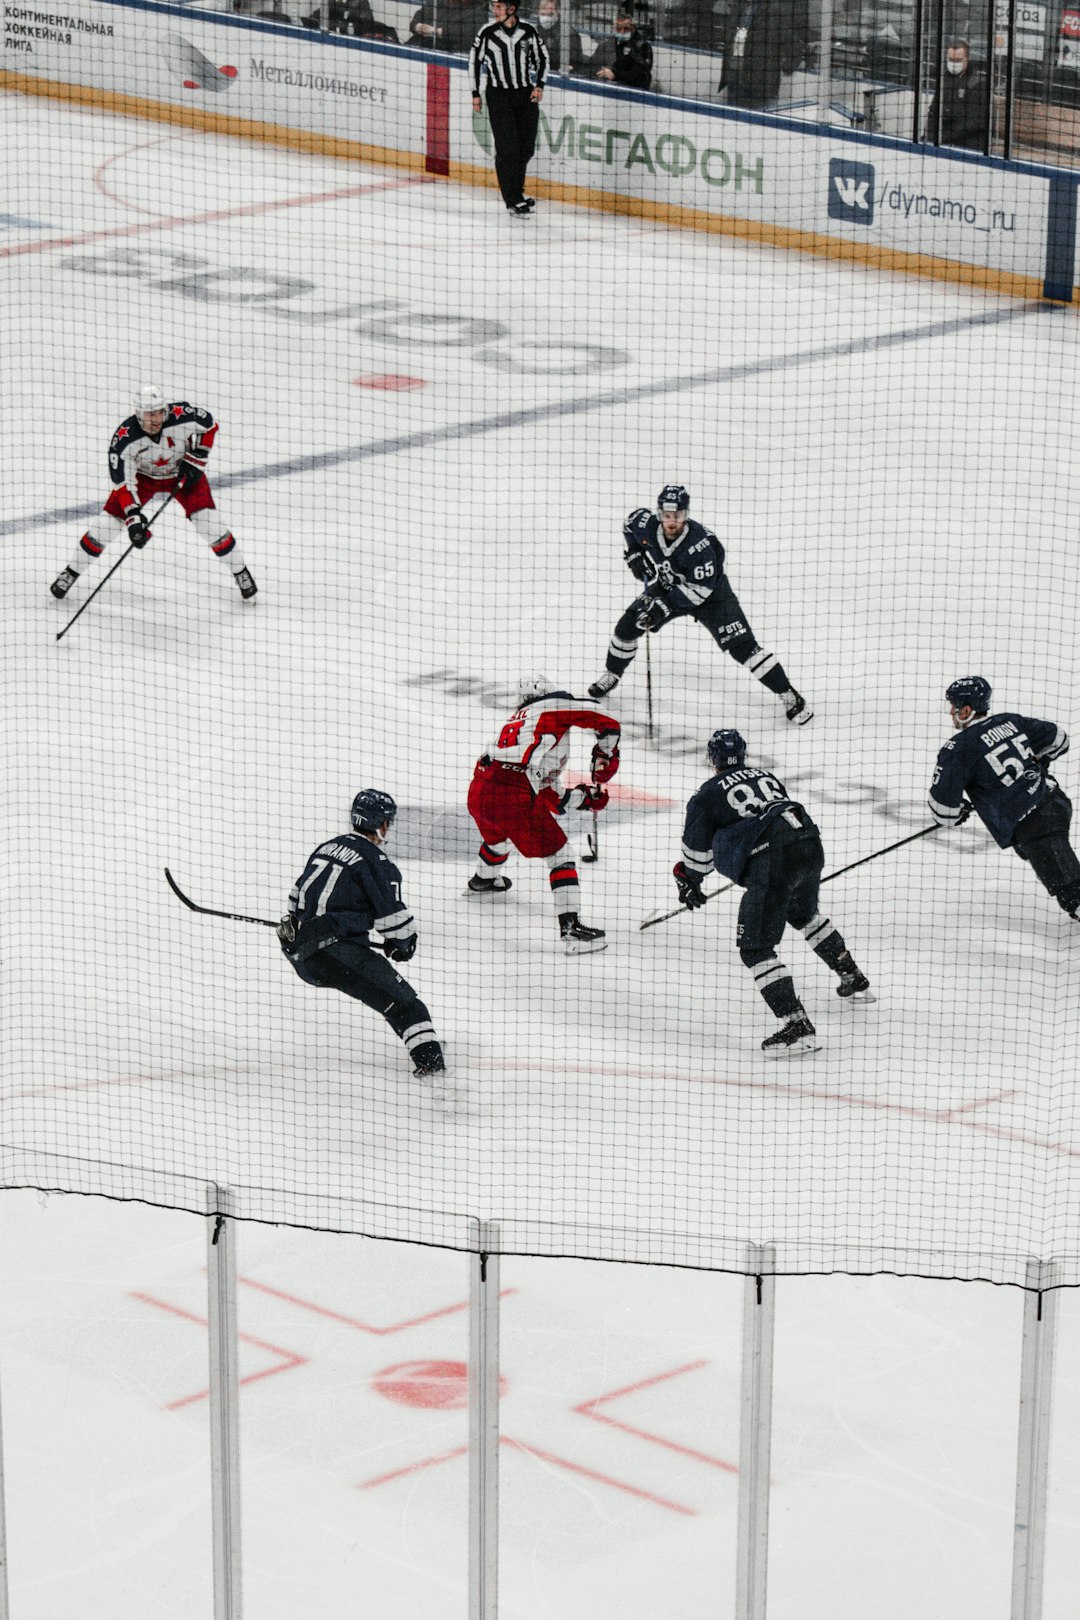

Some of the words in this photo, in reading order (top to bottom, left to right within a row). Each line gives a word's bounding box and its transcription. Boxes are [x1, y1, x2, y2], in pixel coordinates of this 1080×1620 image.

[4, 6, 114, 37] КОНТИНЕНТАЛЬНАЯ
[4, 22, 72, 45] ХОККЕЙНАЯ
[4, 37, 33, 52] ЛИГА
[249, 57, 388, 103] Металлоинвест
[693, 560, 715, 580] 65
[727, 756, 738, 766] 86
[726, 776, 784, 819] 86
[297, 857, 344, 918] 71
